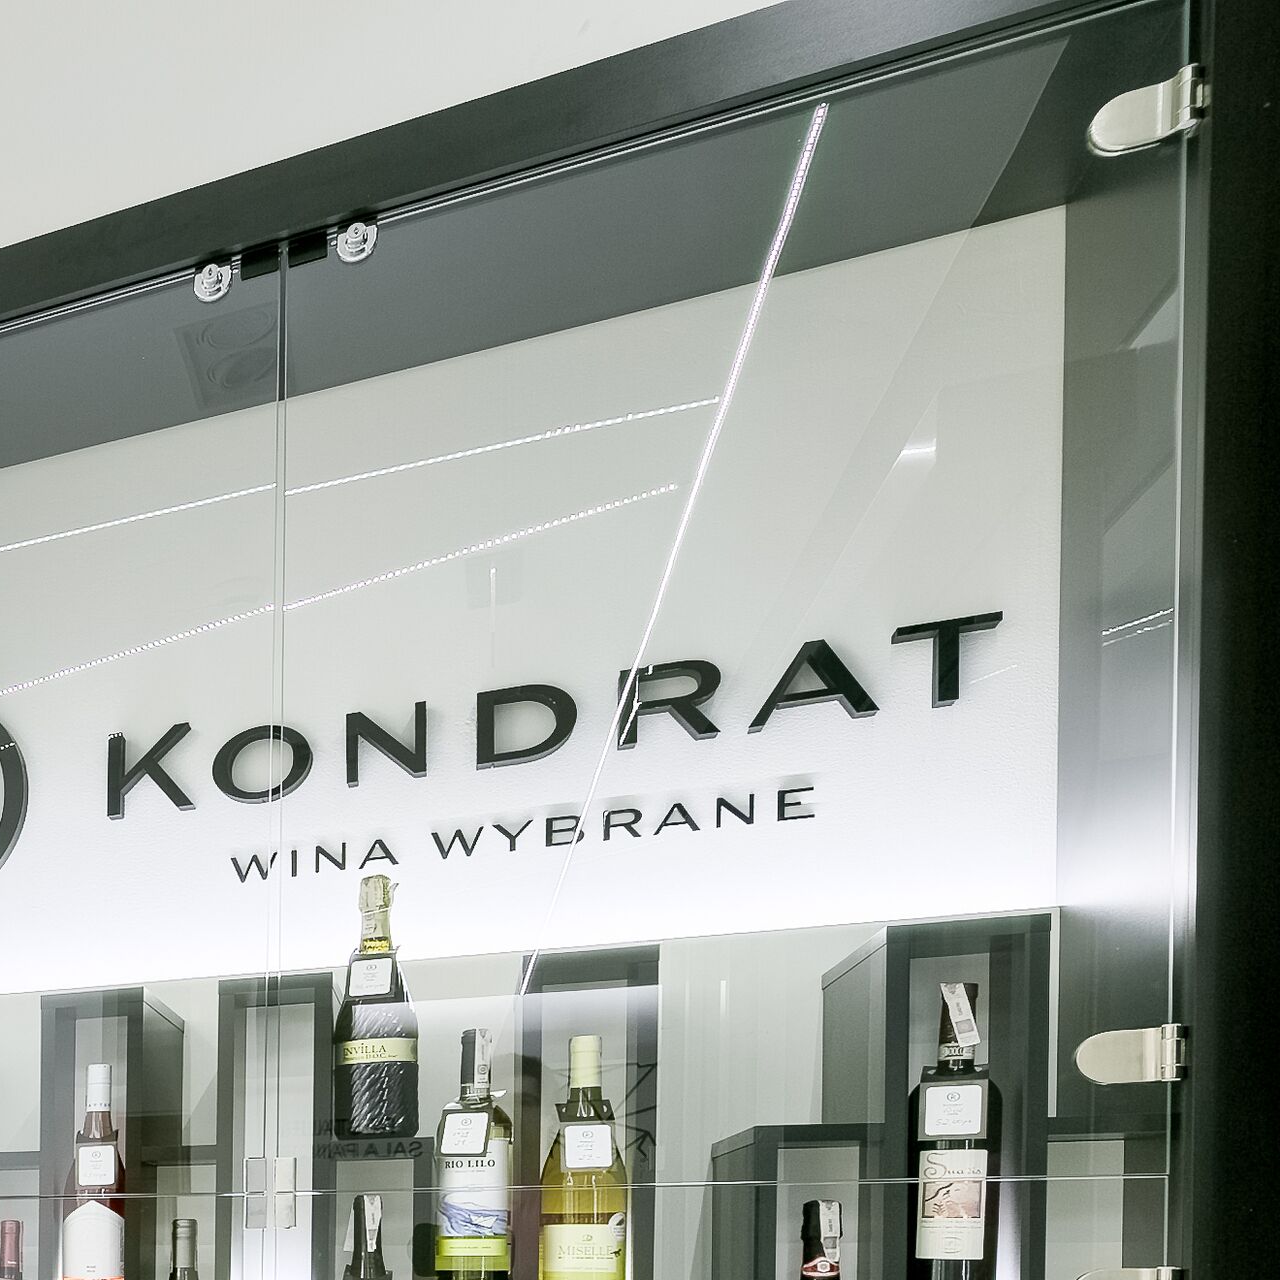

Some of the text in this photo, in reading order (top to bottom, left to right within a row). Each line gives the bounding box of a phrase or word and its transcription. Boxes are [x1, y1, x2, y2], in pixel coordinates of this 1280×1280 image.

[105, 610, 1004, 821] KONDRAT
[230, 786, 817, 885] WINA WYBRANE
[444, 1159, 496, 1169] RIO LILO
